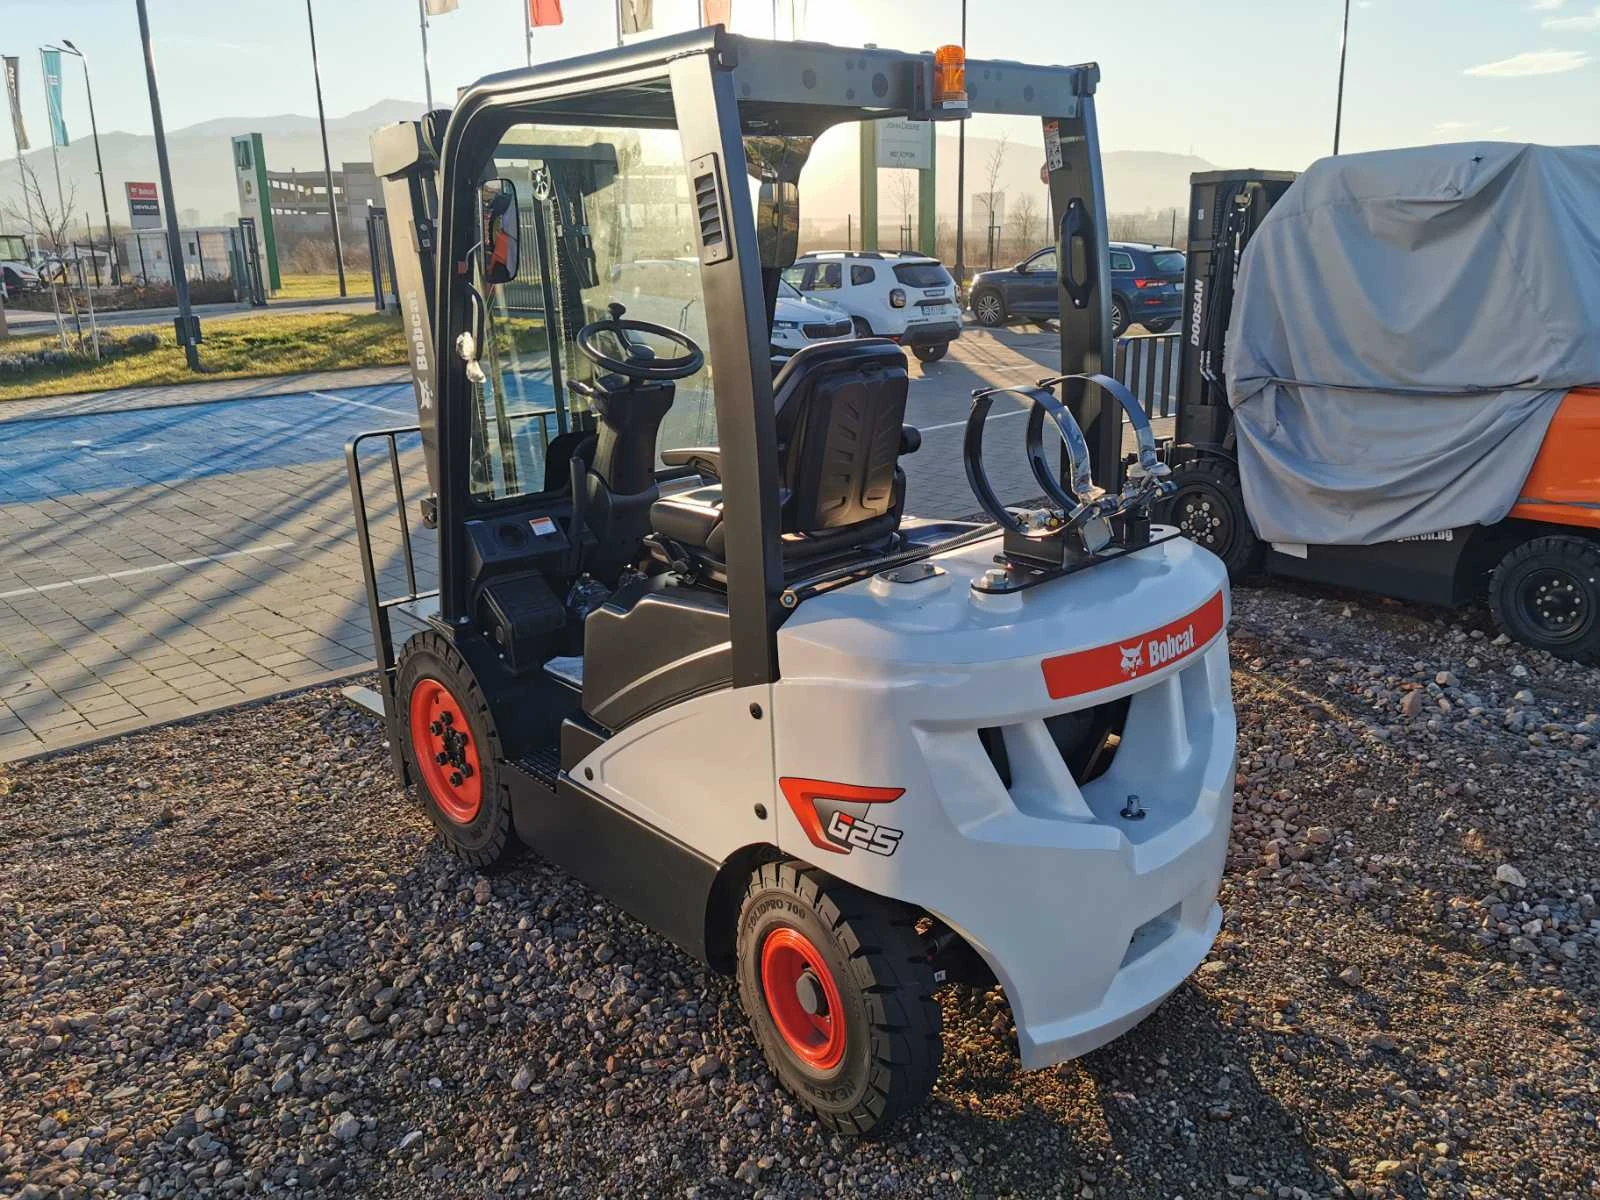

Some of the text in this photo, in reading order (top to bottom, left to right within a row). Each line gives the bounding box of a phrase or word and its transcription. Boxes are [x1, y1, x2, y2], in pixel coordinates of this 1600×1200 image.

[407, 290, 429, 370] Bobcat
[1191, 279, 1204, 346] DOOSAN
[1148, 623, 1195, 668] Bobcat
[827, 809, 904, 857] G25
[748, 899, 806, 934] SOLIDPRO 700
